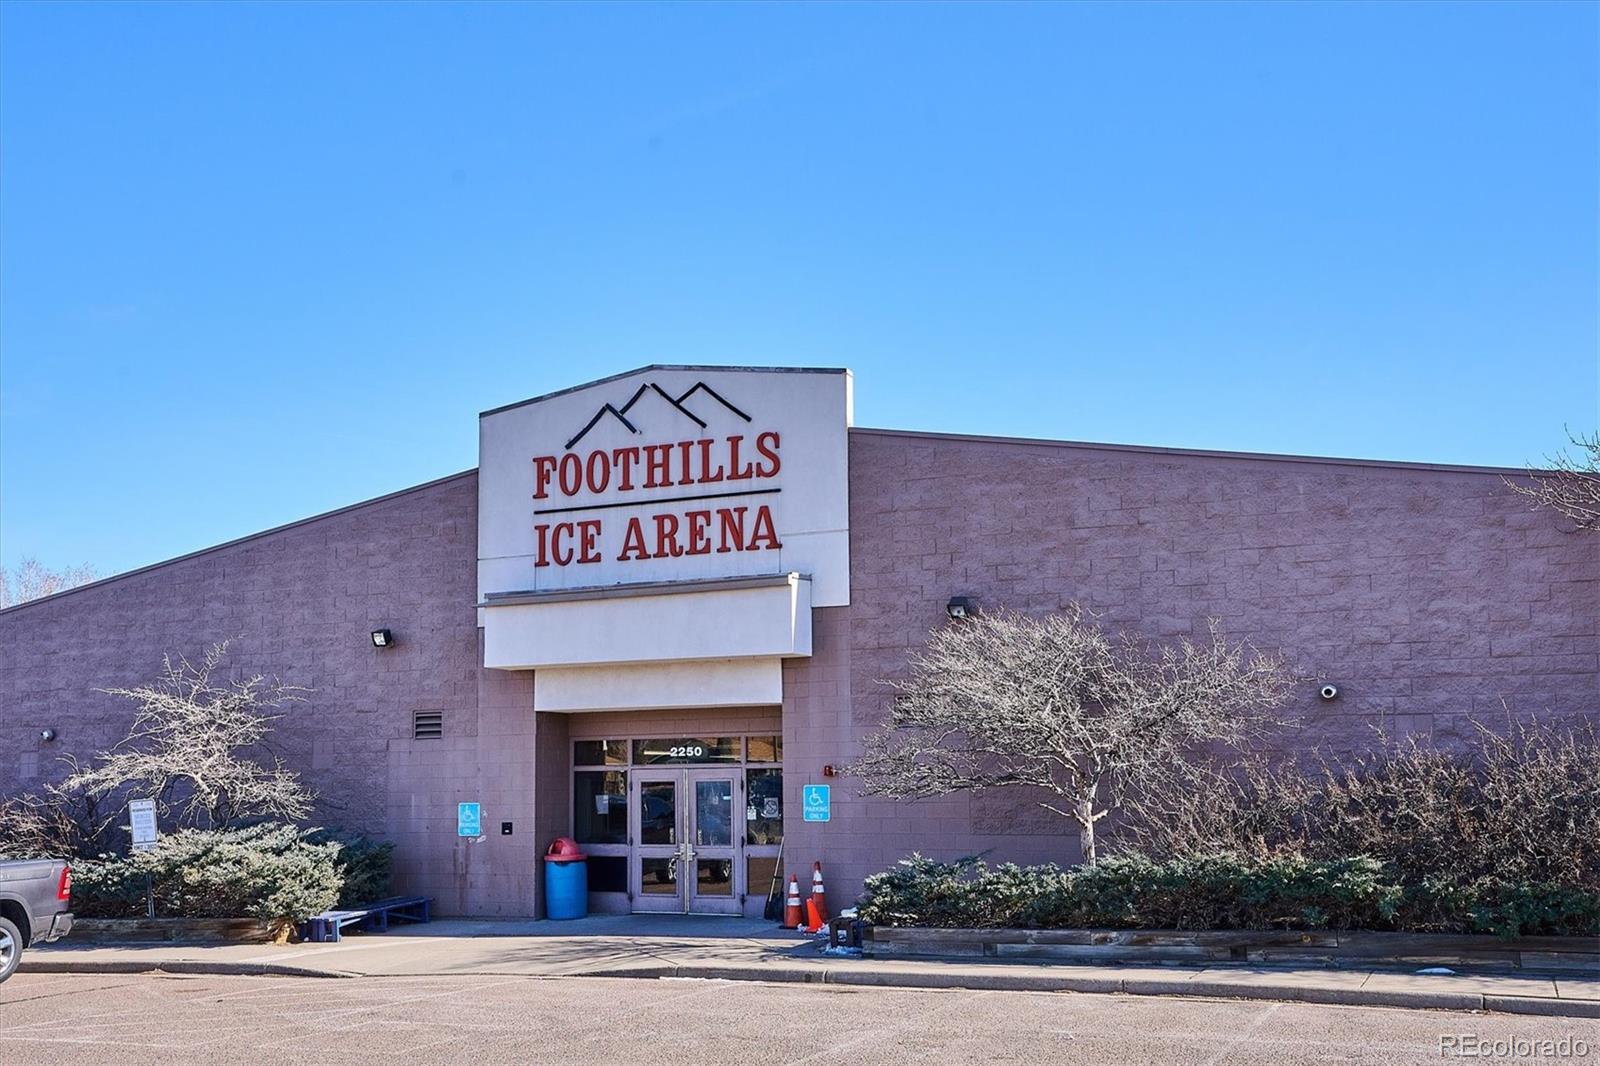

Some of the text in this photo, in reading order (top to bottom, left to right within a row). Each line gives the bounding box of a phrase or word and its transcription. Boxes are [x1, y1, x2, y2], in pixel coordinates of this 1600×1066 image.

[532, 432, 781, 499] FOOTHILLS
[534, 505, 783, 567] ICE ARENA
[670, 746, 703, 757] 2250
